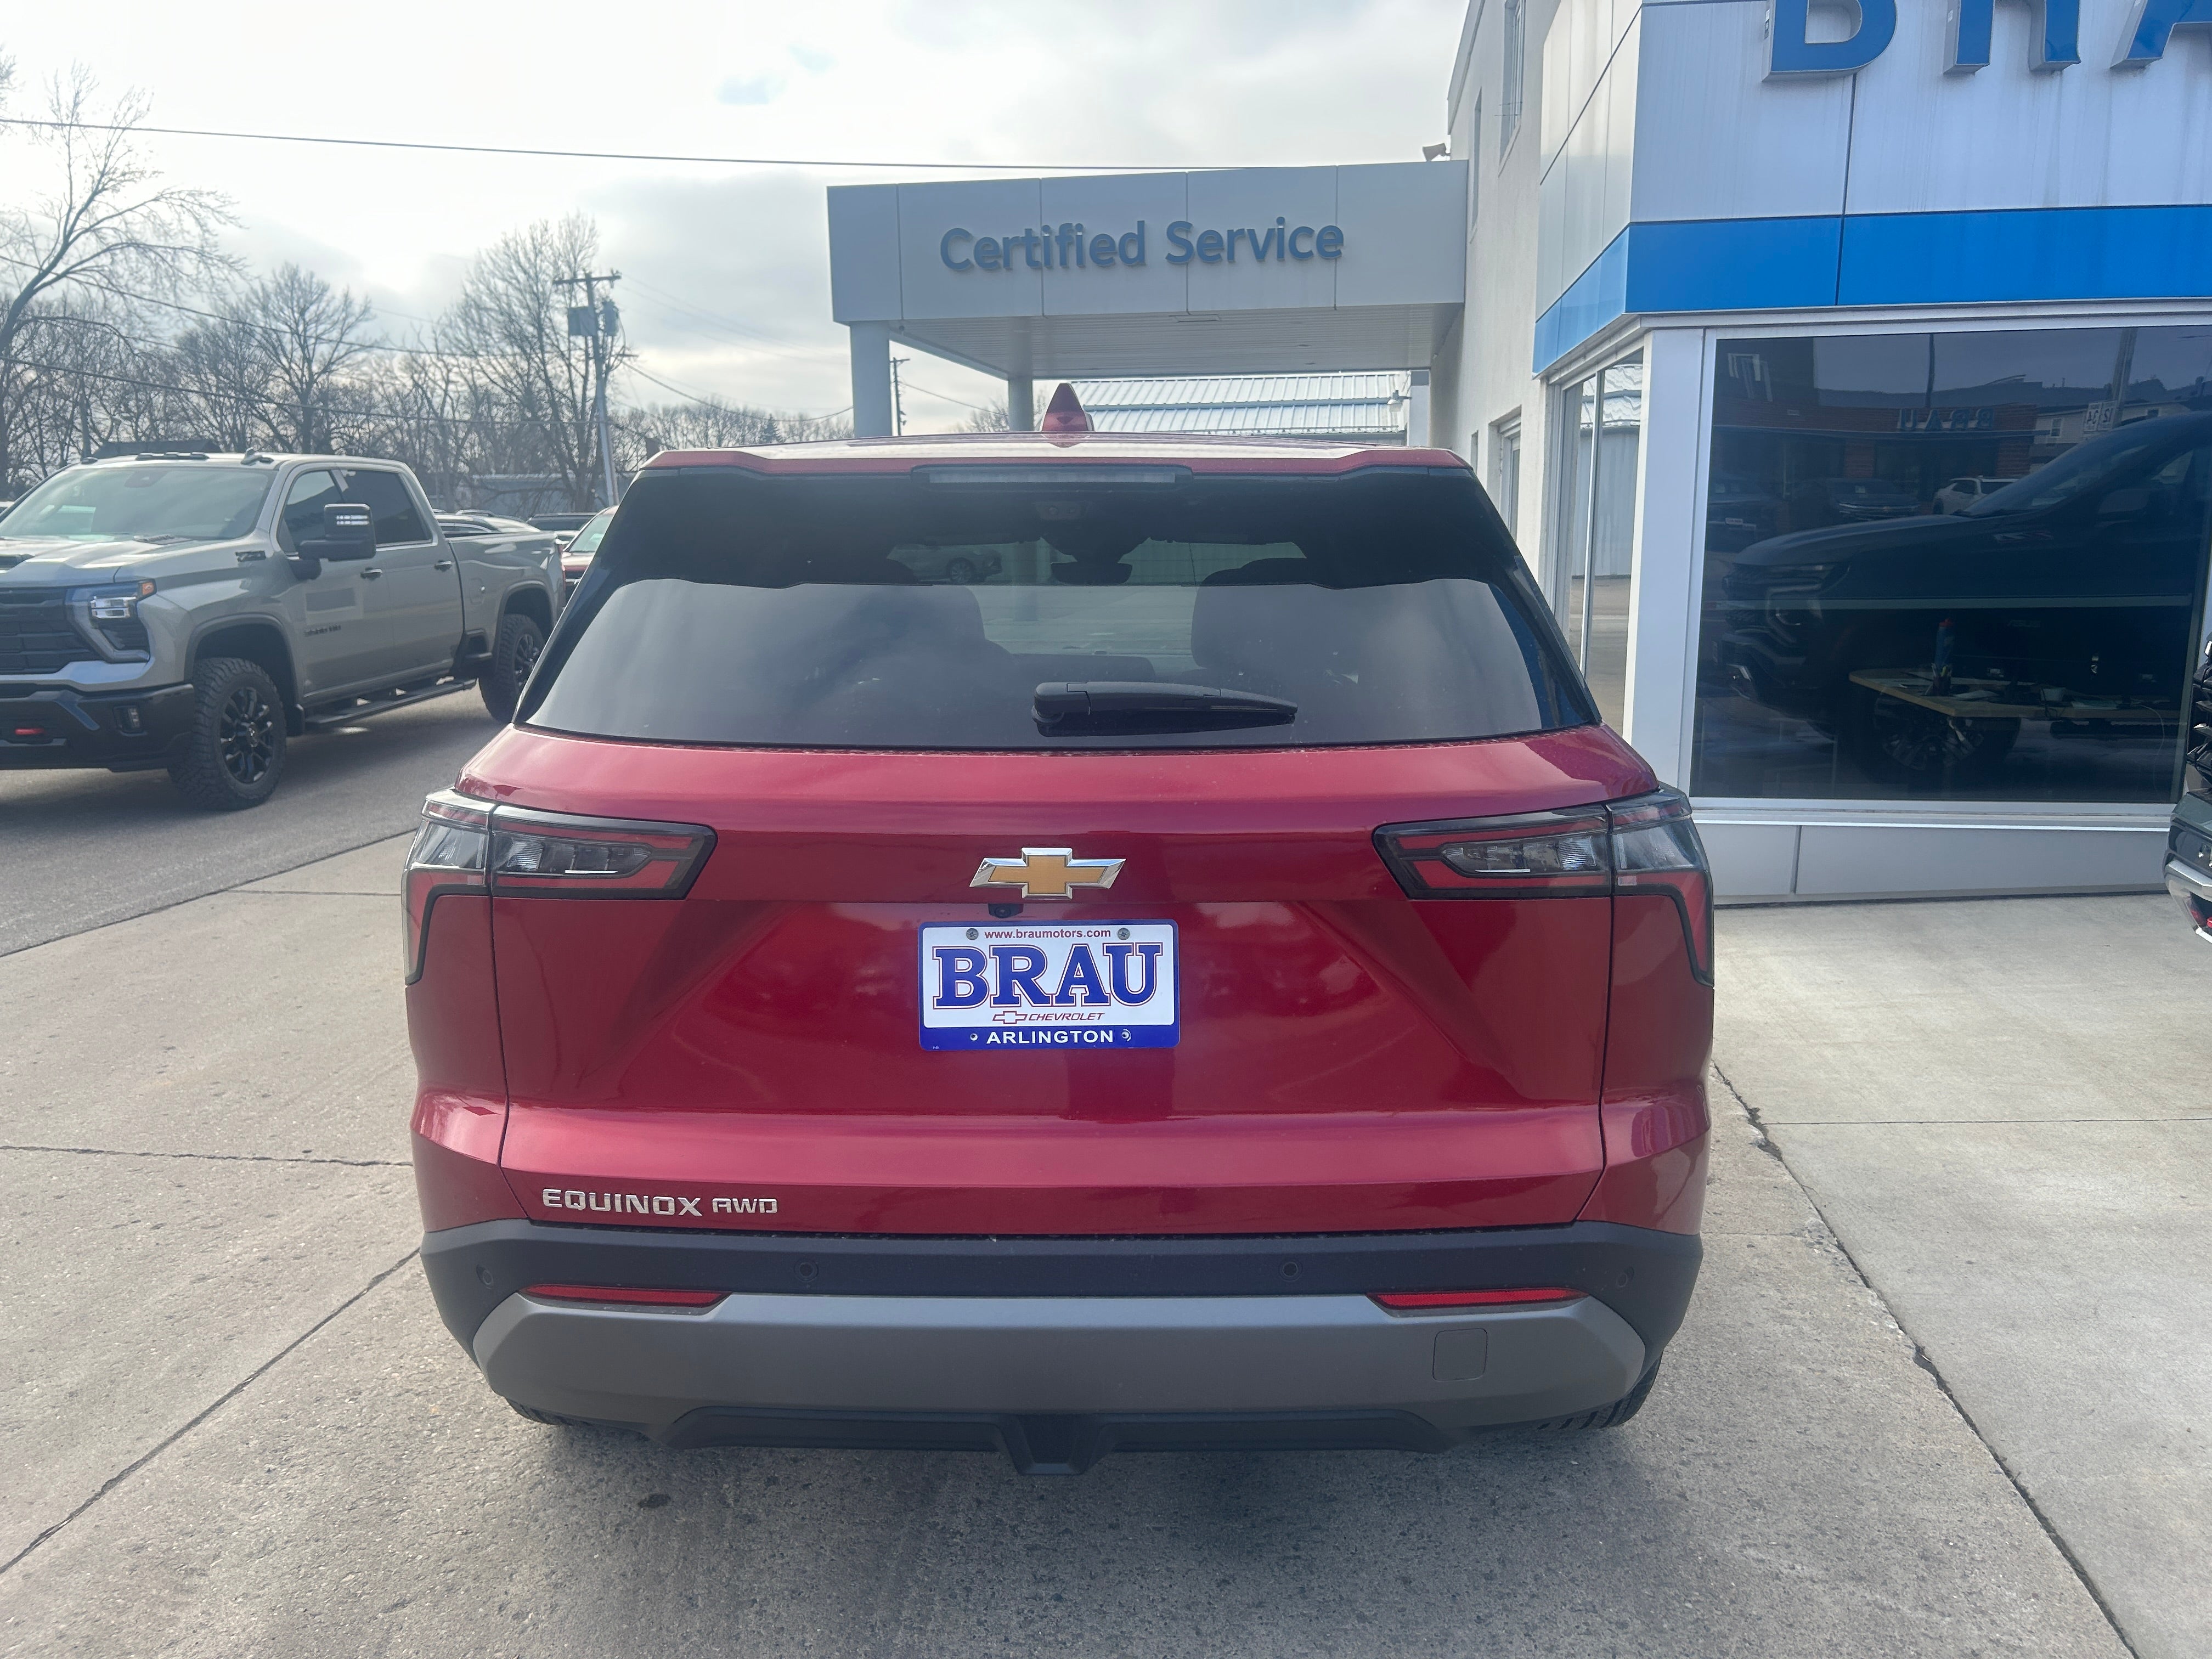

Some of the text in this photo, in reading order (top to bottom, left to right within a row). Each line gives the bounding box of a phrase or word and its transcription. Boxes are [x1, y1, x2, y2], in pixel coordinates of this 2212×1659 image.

[940, 217, 1344, 270] Certified Service
[984, 928, 1111, 940] www.braumotors.com
[932, 941, 1164, 1009] BRAU
[1028, 1012, 1105, 1022] CHEVROLET
[986, 1029, 1114, 1045] ARLINGTON
[542, 1188, 778, 1217] EQUINOX AWD
